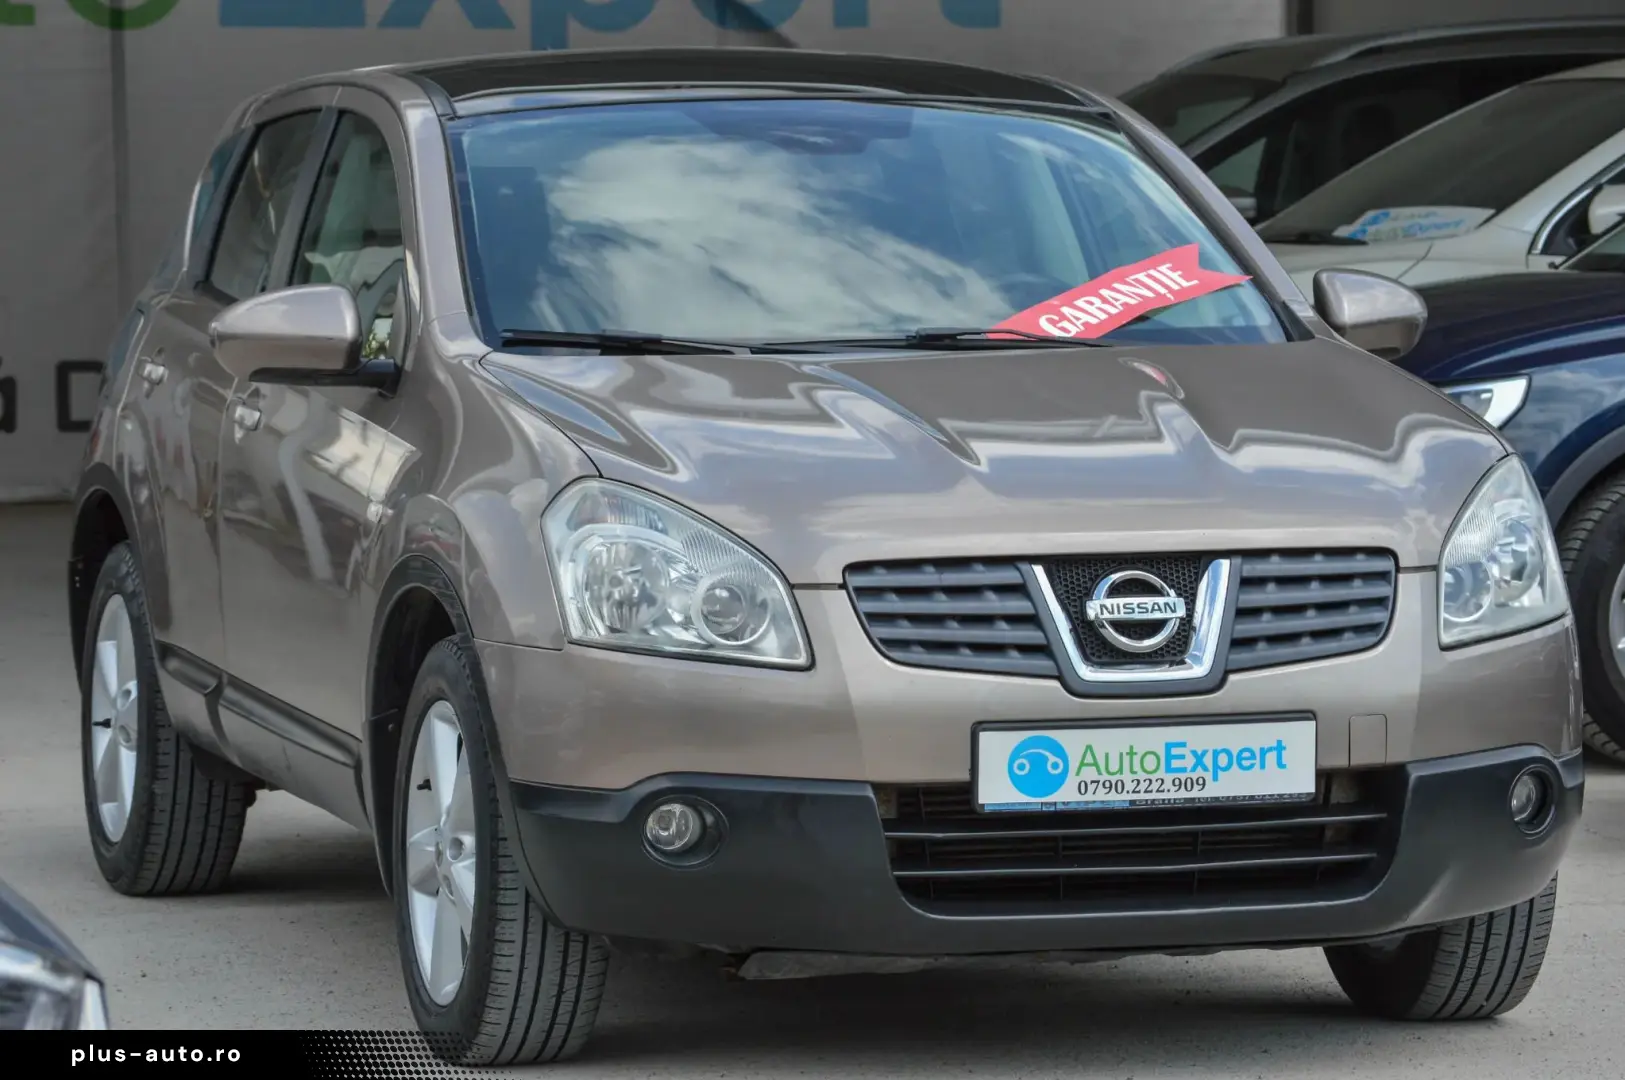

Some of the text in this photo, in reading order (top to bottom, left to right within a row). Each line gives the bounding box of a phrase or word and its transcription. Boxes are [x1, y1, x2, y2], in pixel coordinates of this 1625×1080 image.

[1100, 602, 1177, 616] NISSAN
[1075, 739, 1287, 782] AutoExpert
[1078, 776, 1207, 795] 0790.222.909
